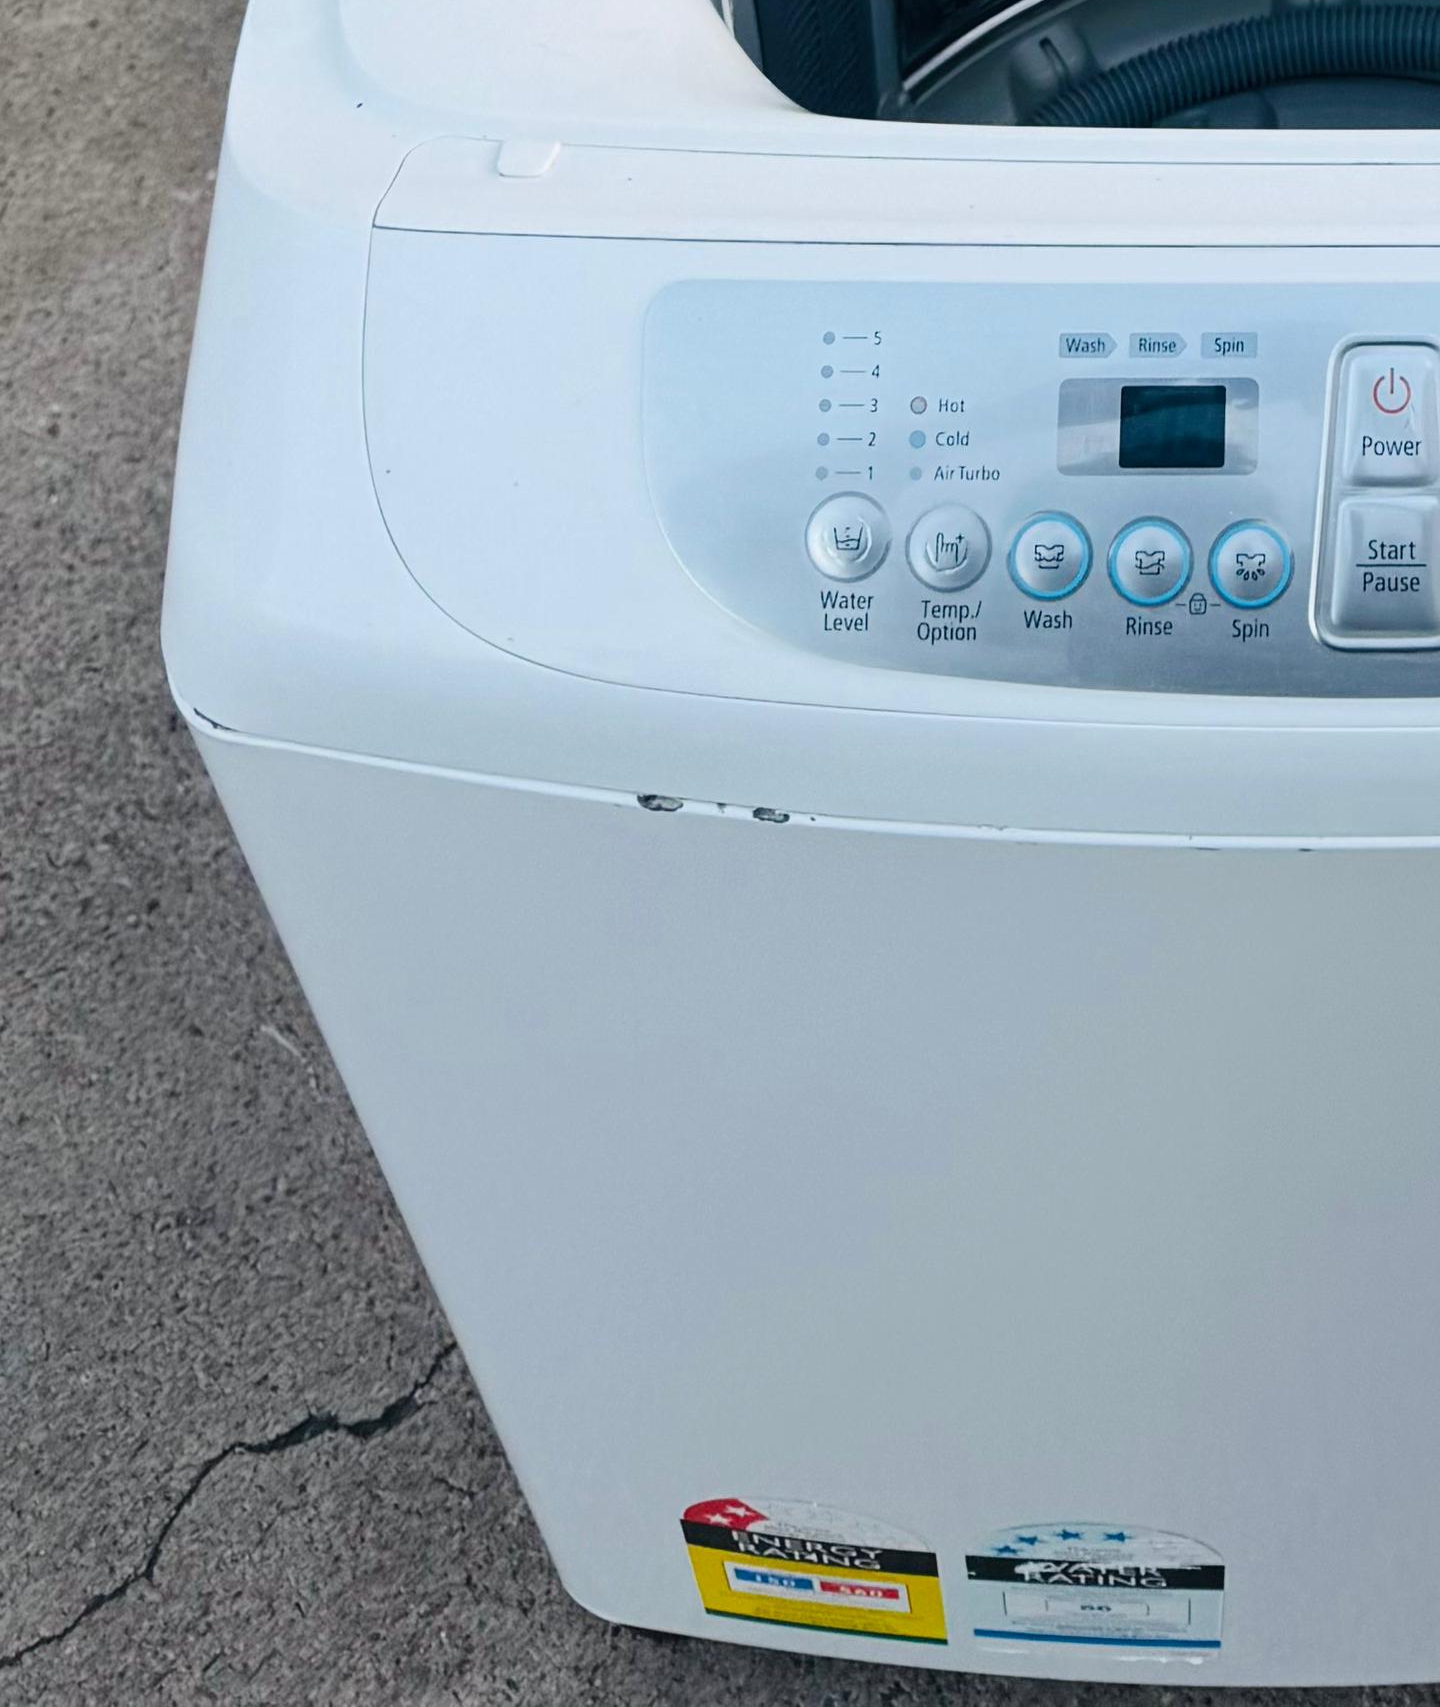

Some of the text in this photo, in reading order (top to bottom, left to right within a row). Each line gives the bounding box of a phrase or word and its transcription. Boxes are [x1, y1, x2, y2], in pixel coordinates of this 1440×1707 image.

[874, 331, 882, 345] 5
[1066, 338, 1105, 354] Wash
[1138, 337, 1177, 353] Rinse
[1214, 337, 1244, 355] Spin
[871, 364, 880, 379] 4
[870, 398, 878, 413] 3
[938, 398, 965, 413] Hot
[868, 431, 876, 447] 2
[935, 431, 970, 447] Cold
[1362, 436, 1422, 456] Power
[868, 466, 873, 480] 1
[933, 466, 1001, 481] Air Turbo
[1368, 540, 1417, 560] Start
[1363, 571, 1421, 592] Pause
[820, 591, 875, 610] Water
[921, 600, 983, 623] Temp./
[1023, 609, 1073, 630] Wash
[824, 613, 869, 631] Level
[1125, 616, 1174, 636] Rinse
[1231, 618, 1270, 642] Spin
[916, 622, 977, 645] Option
[731, 1530, 883, 1560] ENERGY
[738, 1542, 882, 1570] RATING
[1022, 1568, 1168, 1587] RATING
